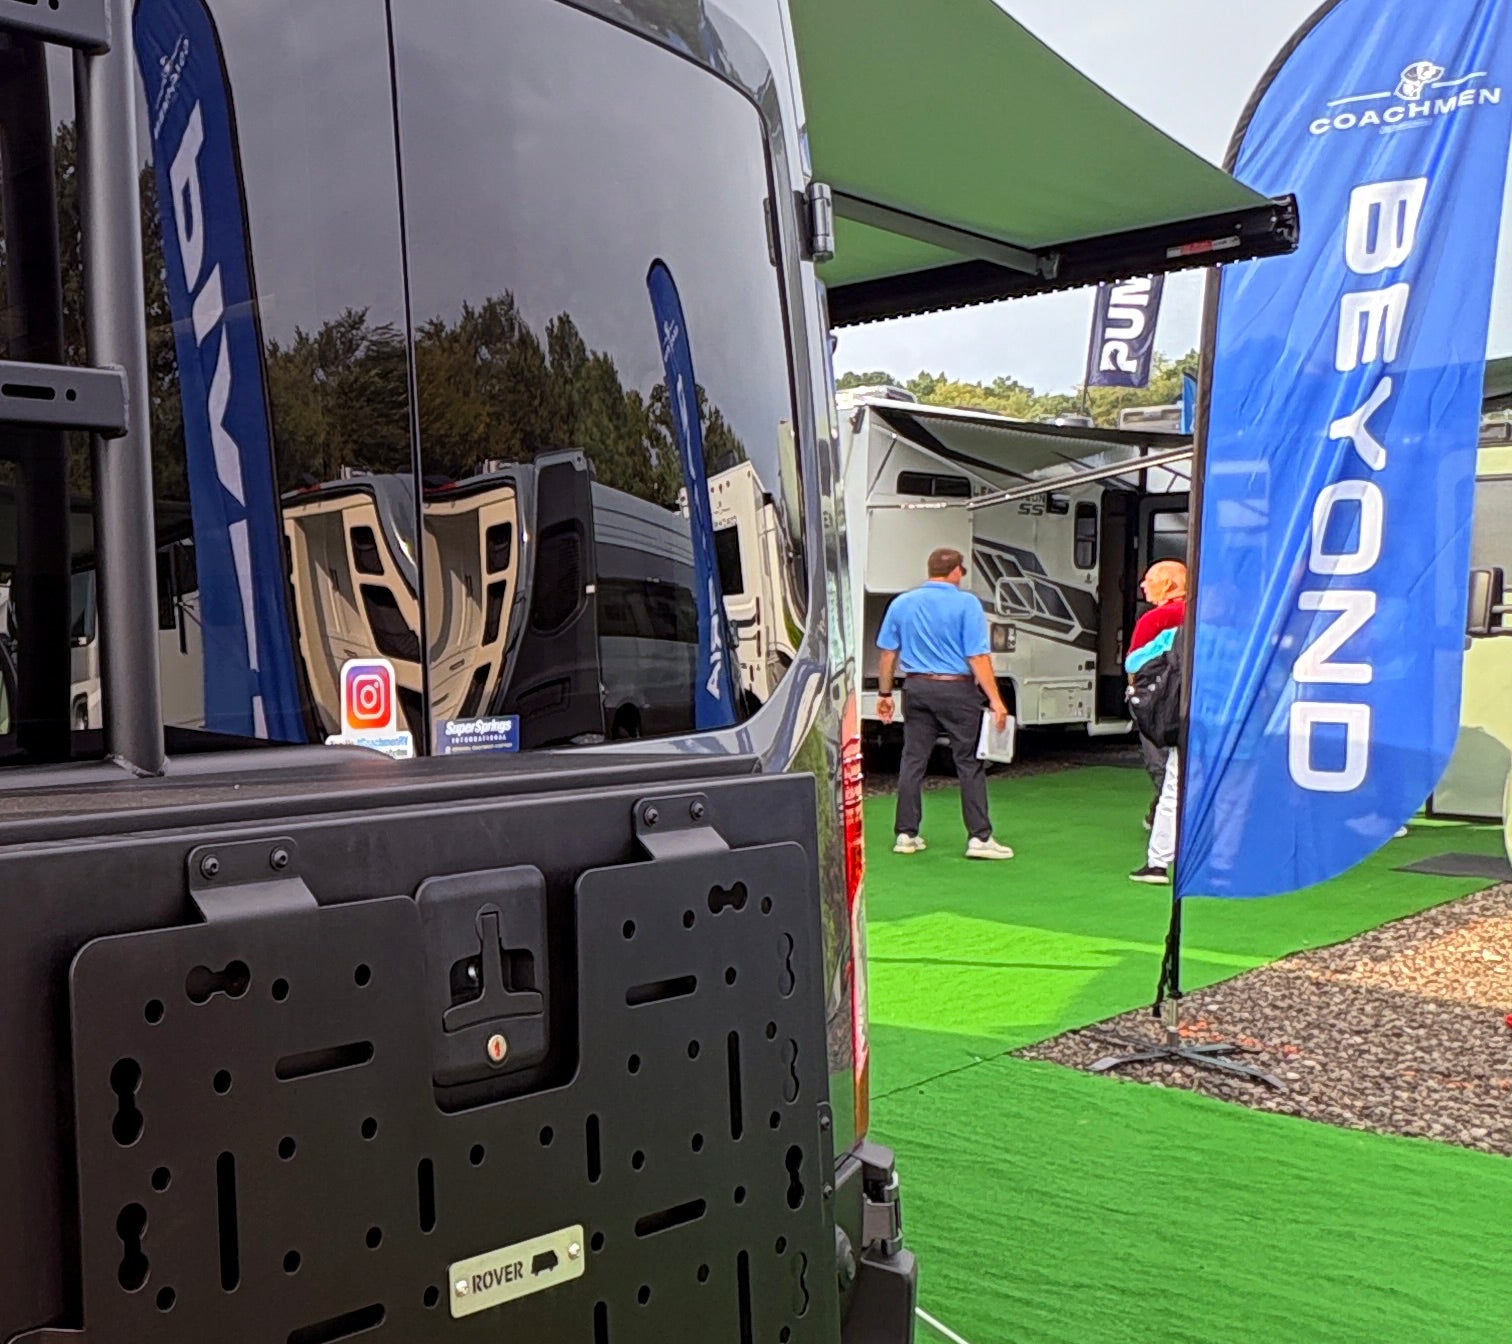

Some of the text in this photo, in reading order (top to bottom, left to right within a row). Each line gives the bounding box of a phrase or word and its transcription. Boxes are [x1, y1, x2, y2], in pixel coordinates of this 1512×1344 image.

[1308, 87, 1502, 136] COACHMEN
[1288, 176, 1428, 793] BEYOND
[471, 1260, 524, 1294] ROVER
